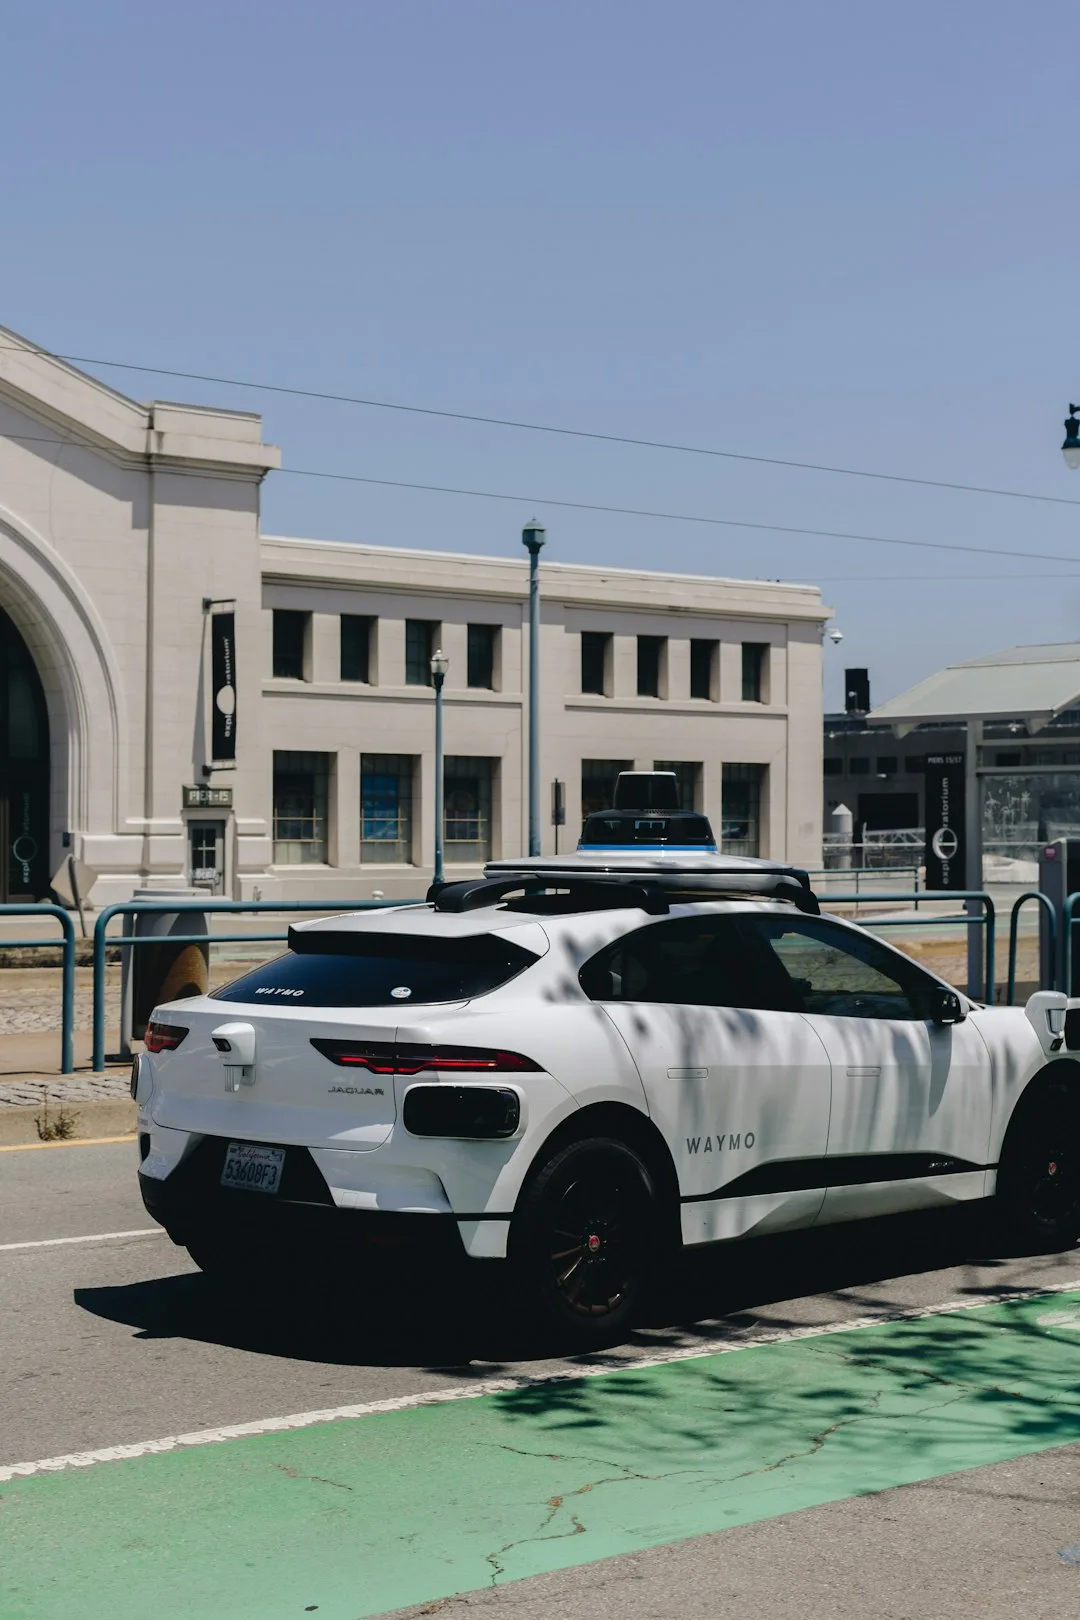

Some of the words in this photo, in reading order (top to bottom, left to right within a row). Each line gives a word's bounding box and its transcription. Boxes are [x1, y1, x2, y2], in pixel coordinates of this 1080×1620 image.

[932, 777, 958, 885] exploratorium
[255, 987, 305, 997] WAYMO
[327, 1086, 385, 1096] JAGUAR
[686, 1132, 755, 1155] WAYMO
